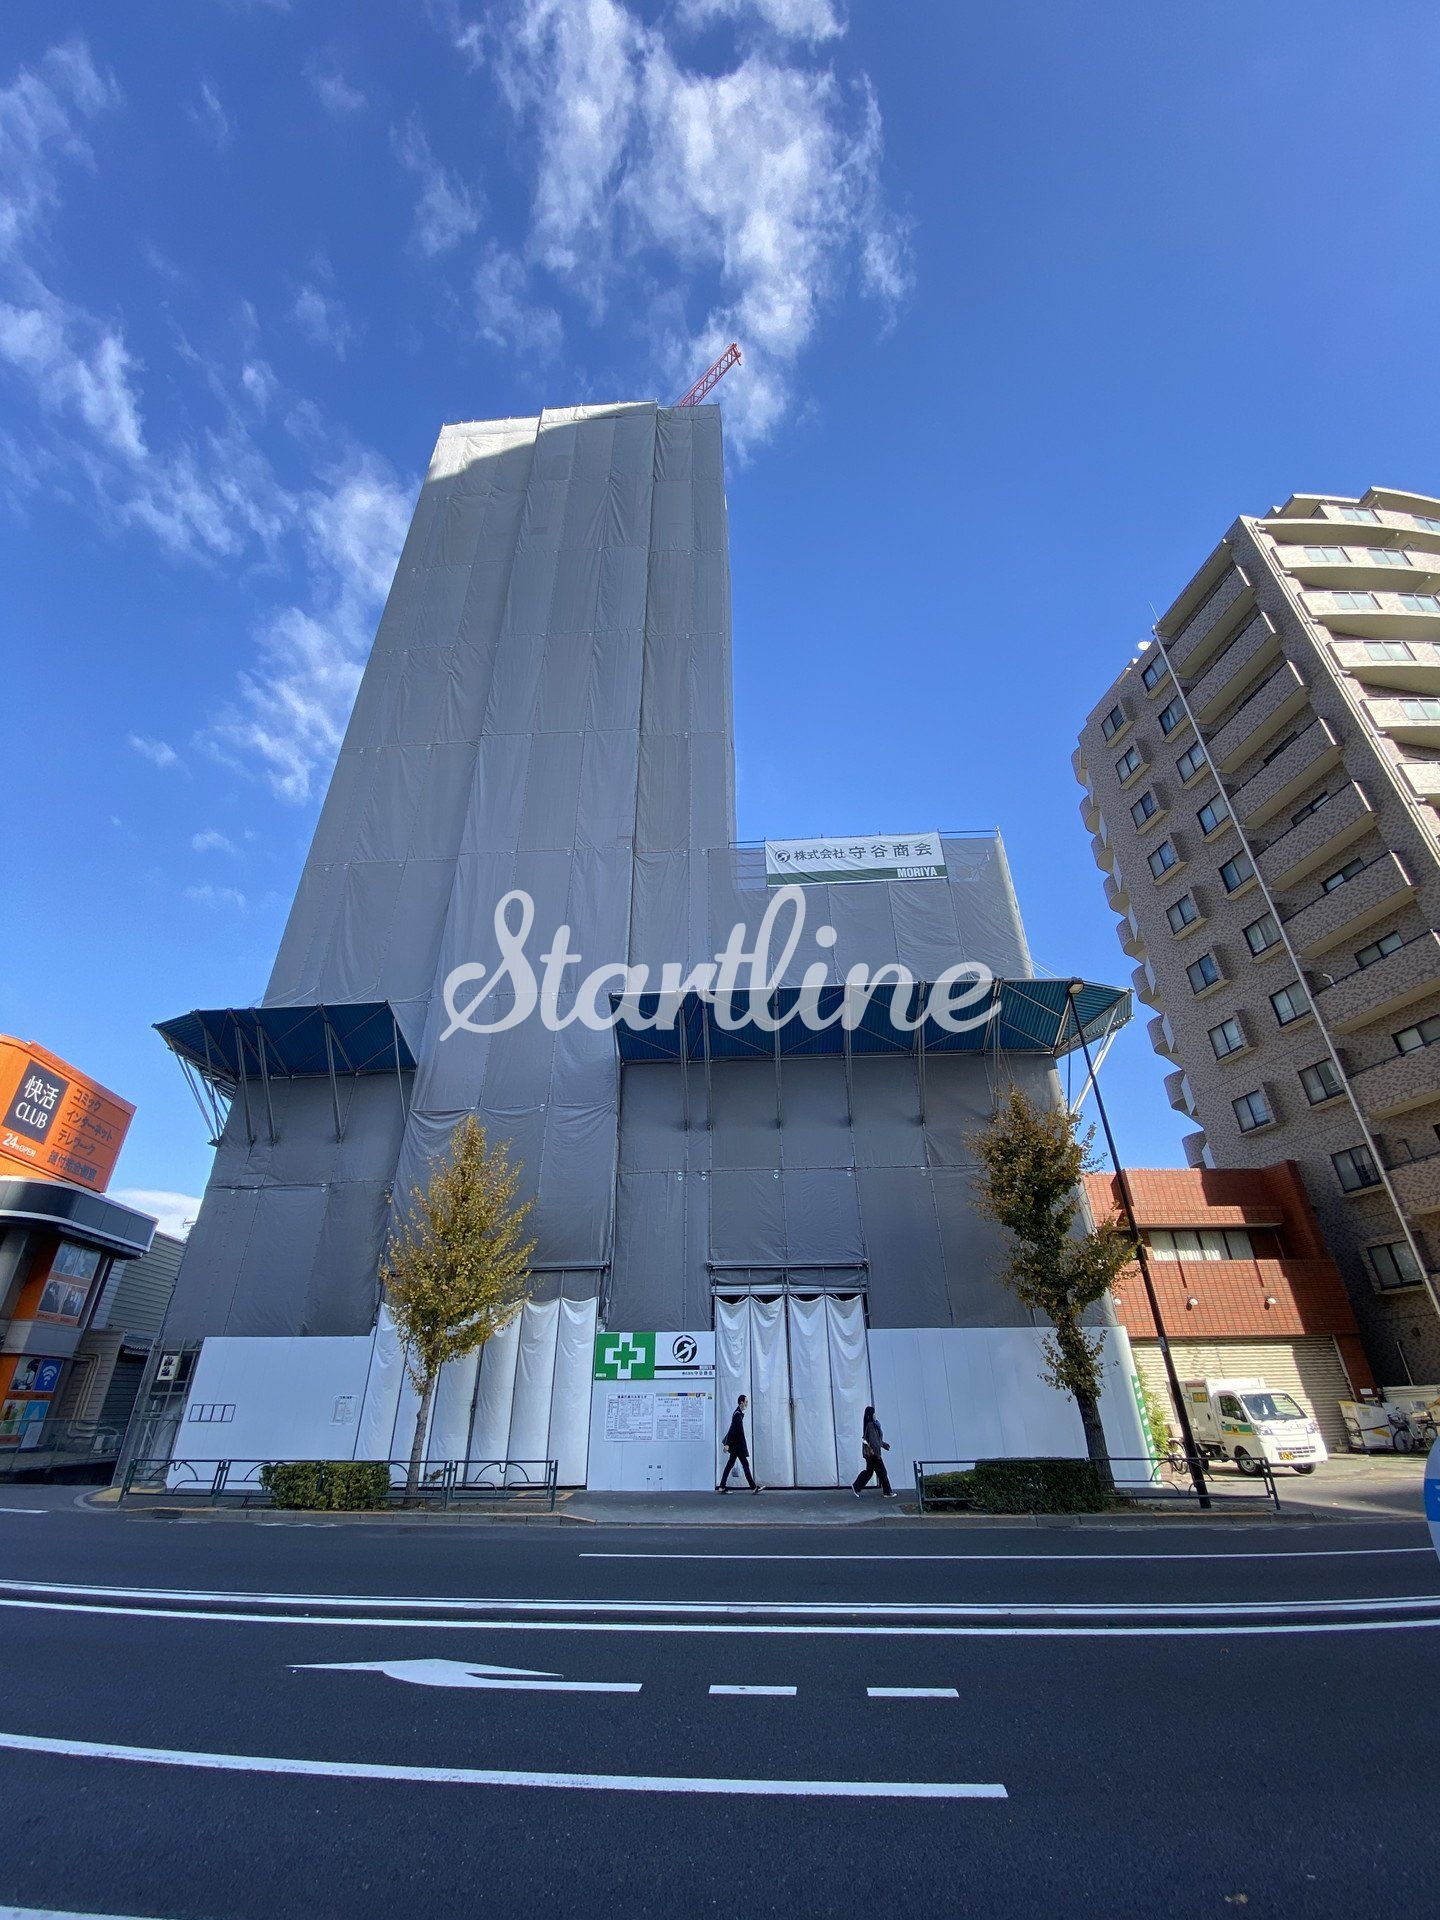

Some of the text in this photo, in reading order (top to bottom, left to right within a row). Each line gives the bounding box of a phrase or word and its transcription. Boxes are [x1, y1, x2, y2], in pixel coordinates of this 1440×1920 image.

[794, 842, 933, 862] 株式会社守谷商会
[896, 866, 938, 878] MORIYA
[25, 1075, 60, 1110] 快活
[73, 1088, 102, 1112] コミック
[16, 1102, 48, 1129] CLUB
[66, 1110, 113, 1142] インターネット
[57, 1129, 96, 1156] テレワーク
